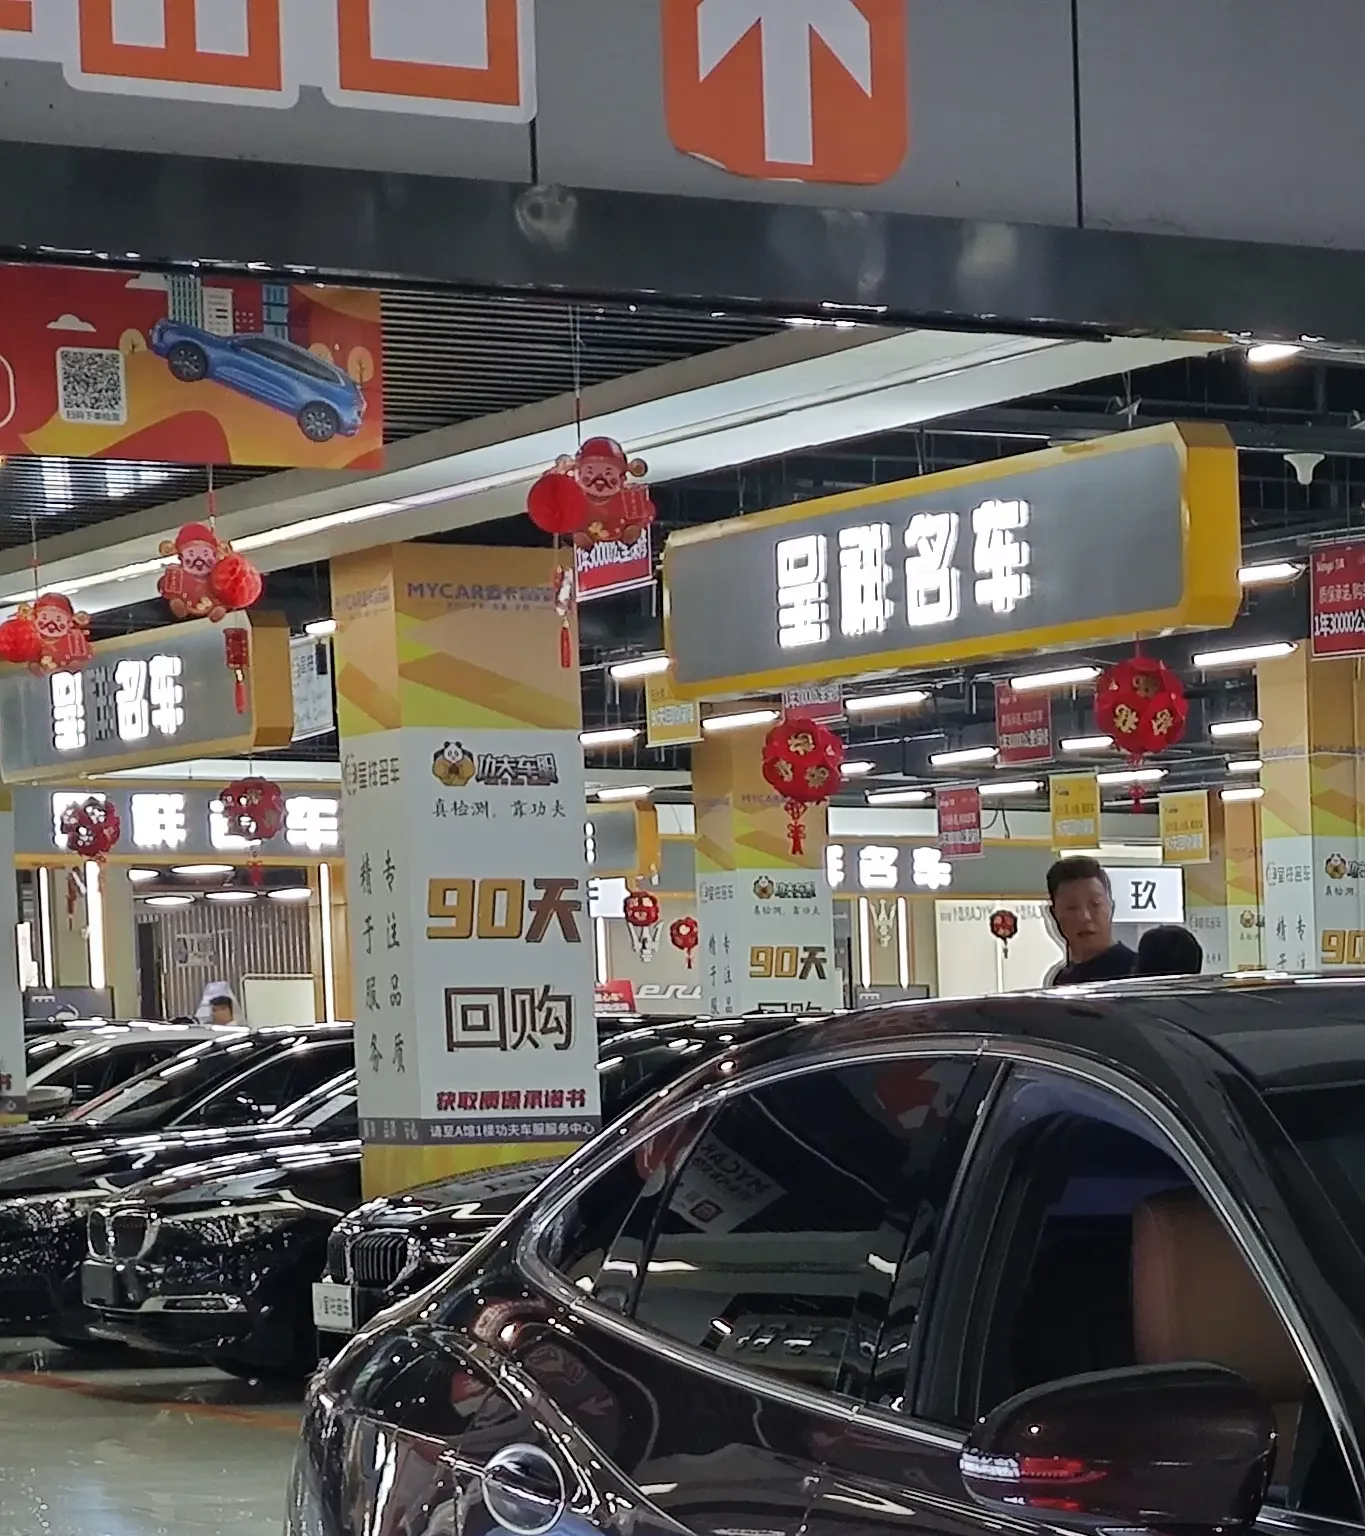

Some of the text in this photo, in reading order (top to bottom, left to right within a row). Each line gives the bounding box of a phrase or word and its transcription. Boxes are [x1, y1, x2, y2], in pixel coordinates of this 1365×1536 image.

[775, 499, 1032, 650] 呈祥名车
[476, 753, 560, 787] 功夫车服
[426, 877, 582, 943] 90天
[1130, 880, 1158, 910] 玖
[749, 946, 828, 980] 90天
[443, 983, 576, 1053] 回购
[435, 1088, 587, 1112] 获取质保承诺书
[428, 1122, 597, 1139] 请至A馆1楼功夫车服服务中心
